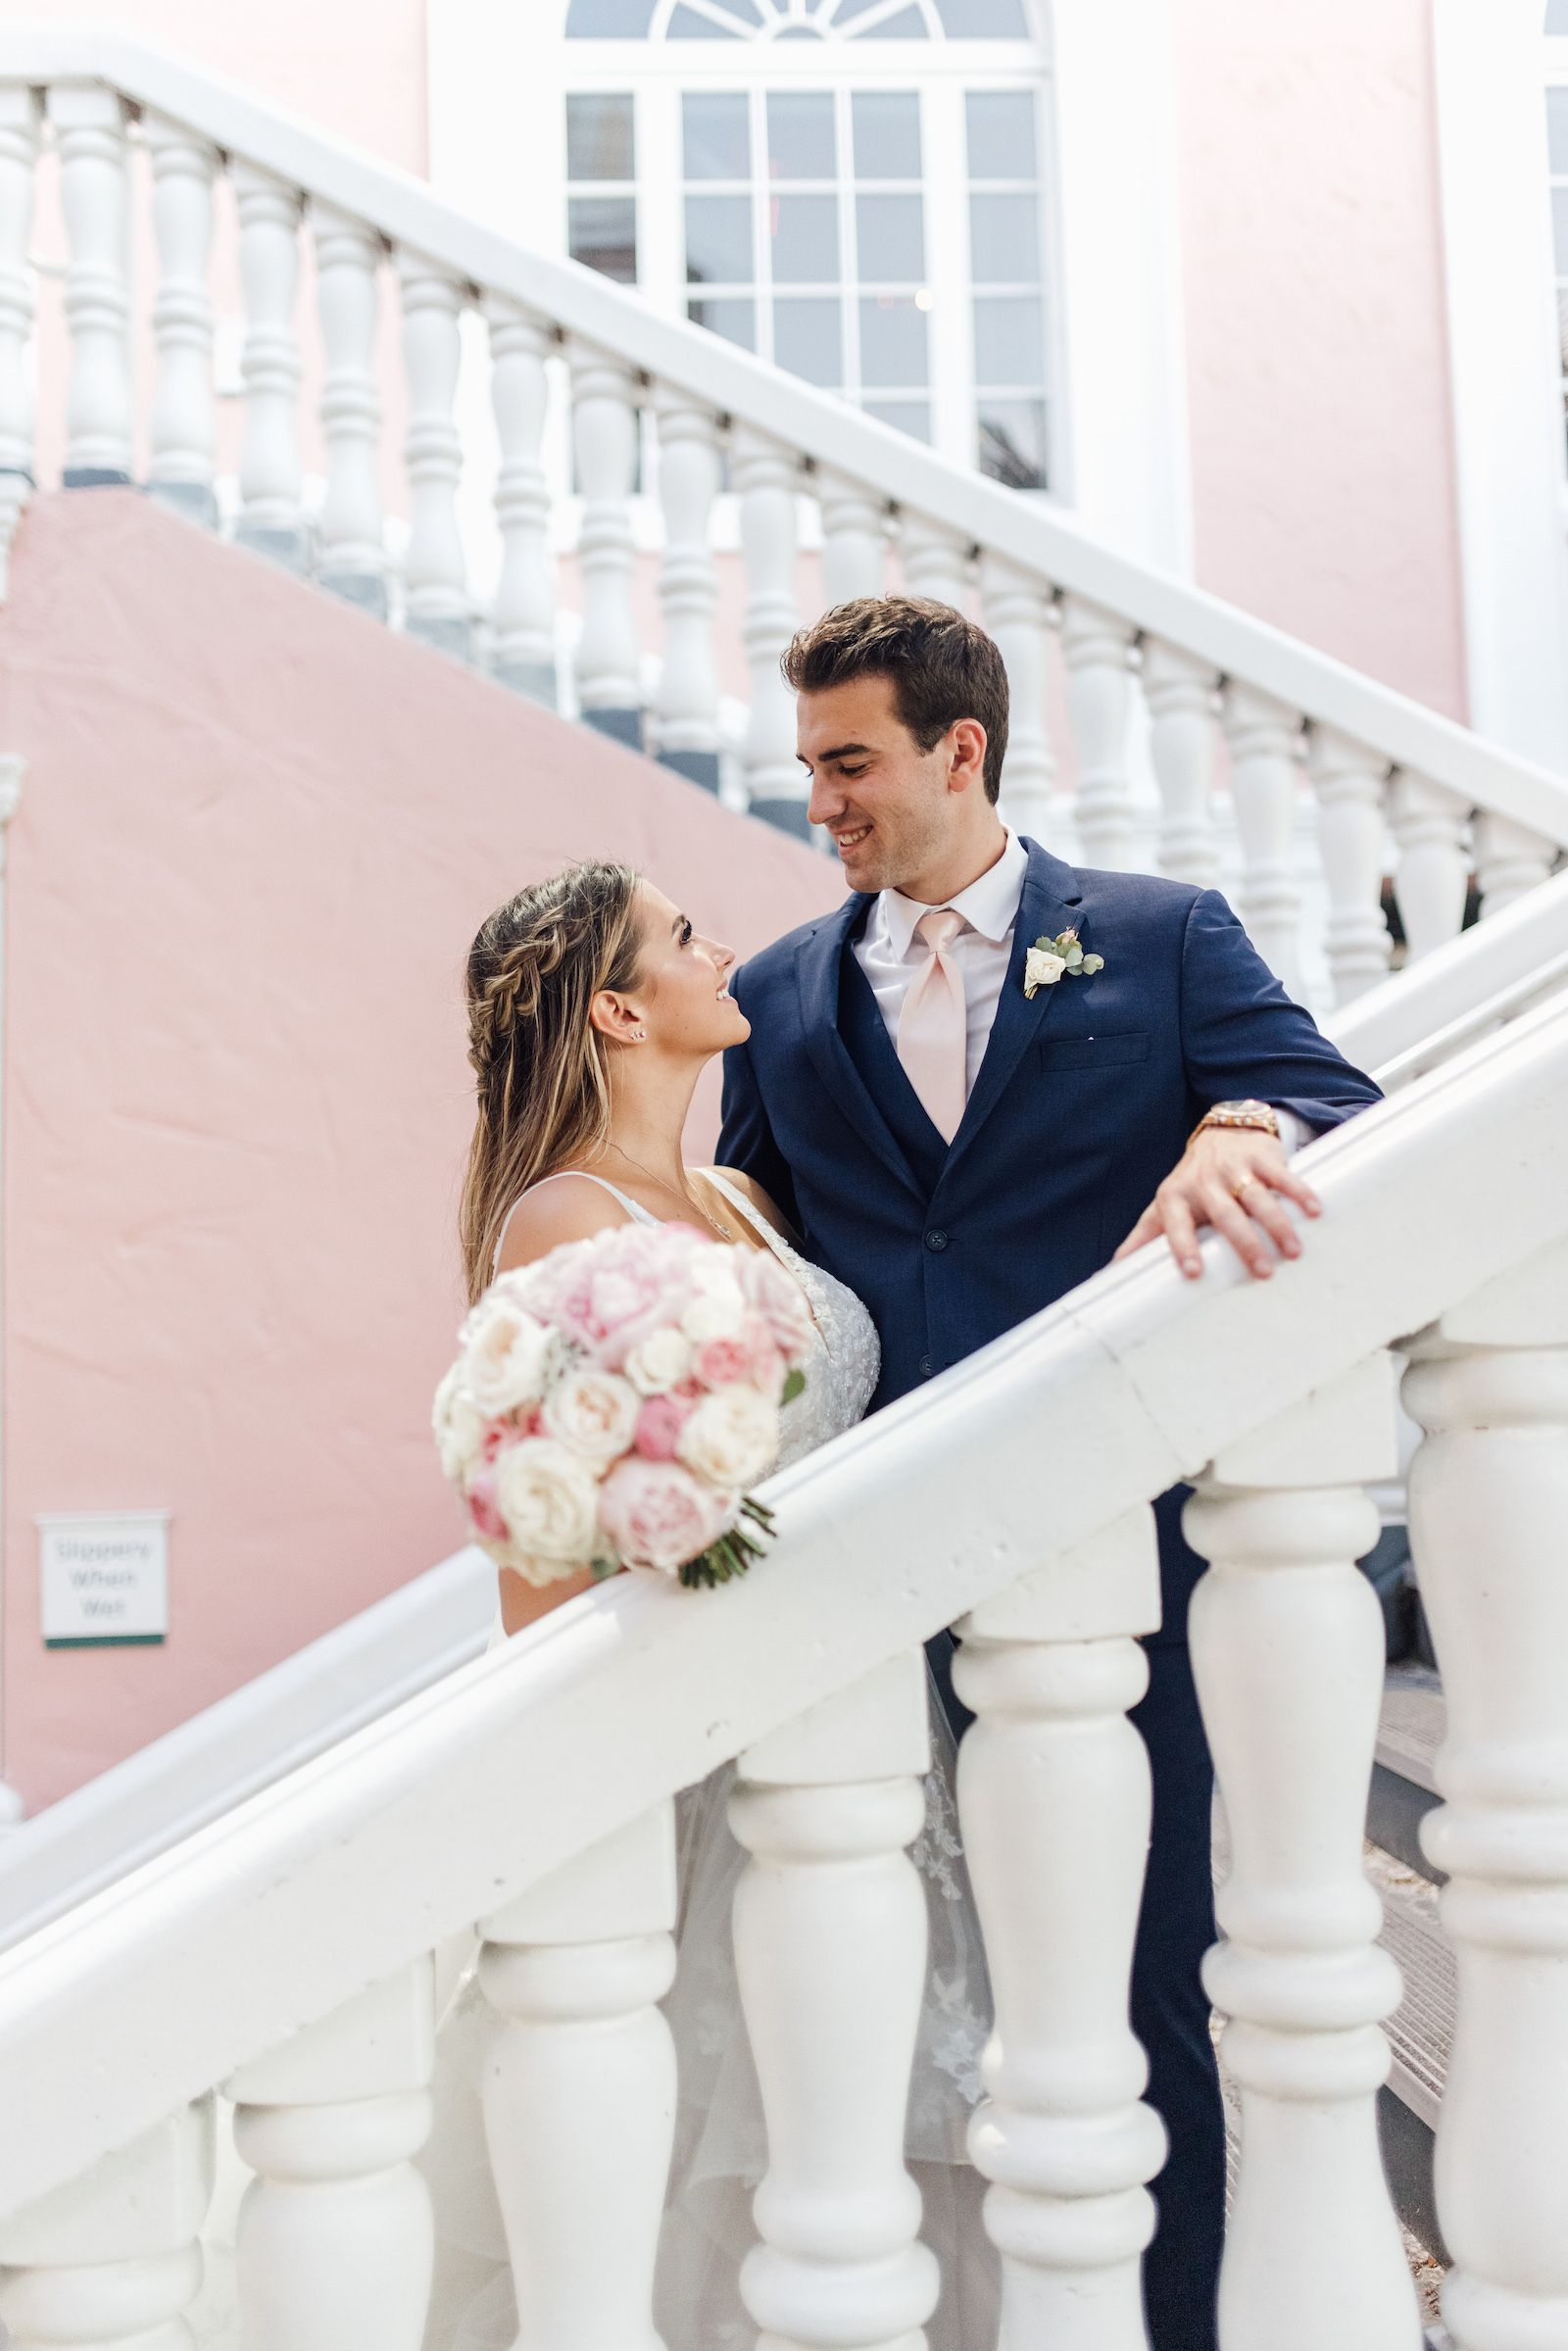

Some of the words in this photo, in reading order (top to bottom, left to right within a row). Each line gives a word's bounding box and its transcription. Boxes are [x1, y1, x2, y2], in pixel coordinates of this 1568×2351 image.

[55, 1538, 150, 1562] Slippery
[70, 1568, 136, 1589] When
[81, 1597, 125, 1619] Wet
